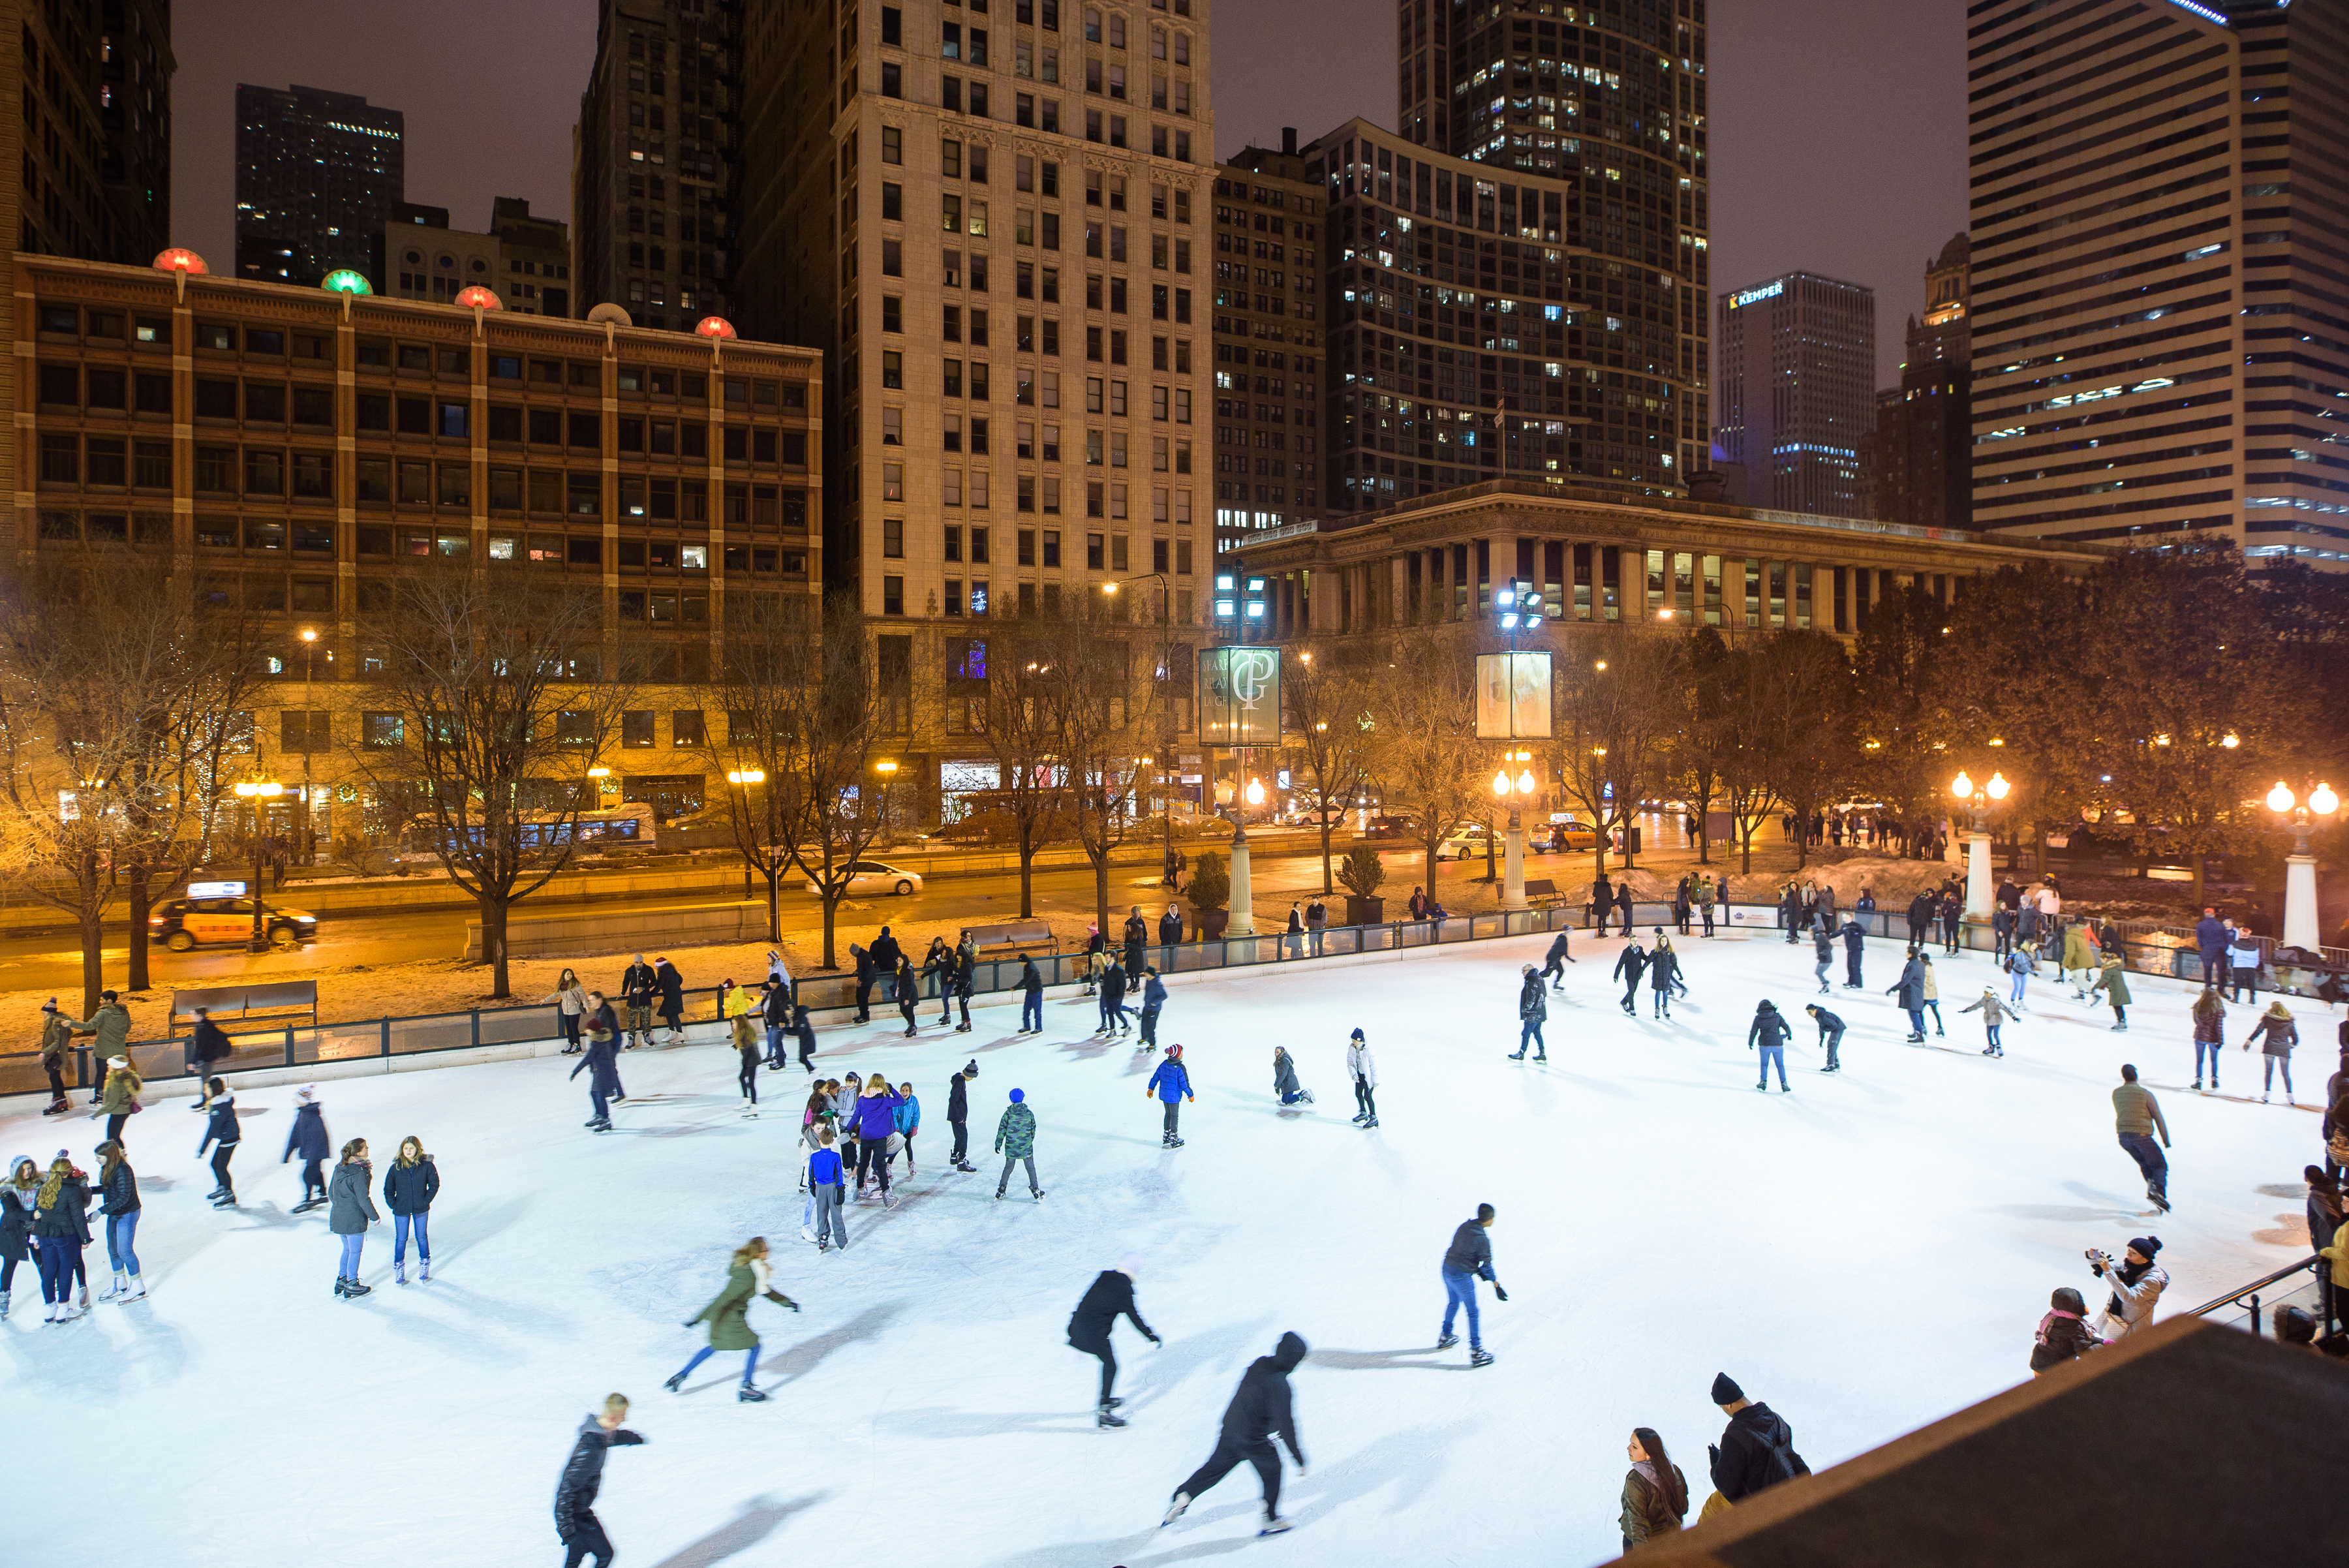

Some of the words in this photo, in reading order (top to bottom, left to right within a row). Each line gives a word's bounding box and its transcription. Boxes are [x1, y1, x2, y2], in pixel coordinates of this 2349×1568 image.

[1738, 283, 1783, 306] KEMPER
[1203, 658, 1227, 671] SHARE
[1204, 677, 1227, 690] RELAX
[1204, 695, 1227, 707] LAUGH
